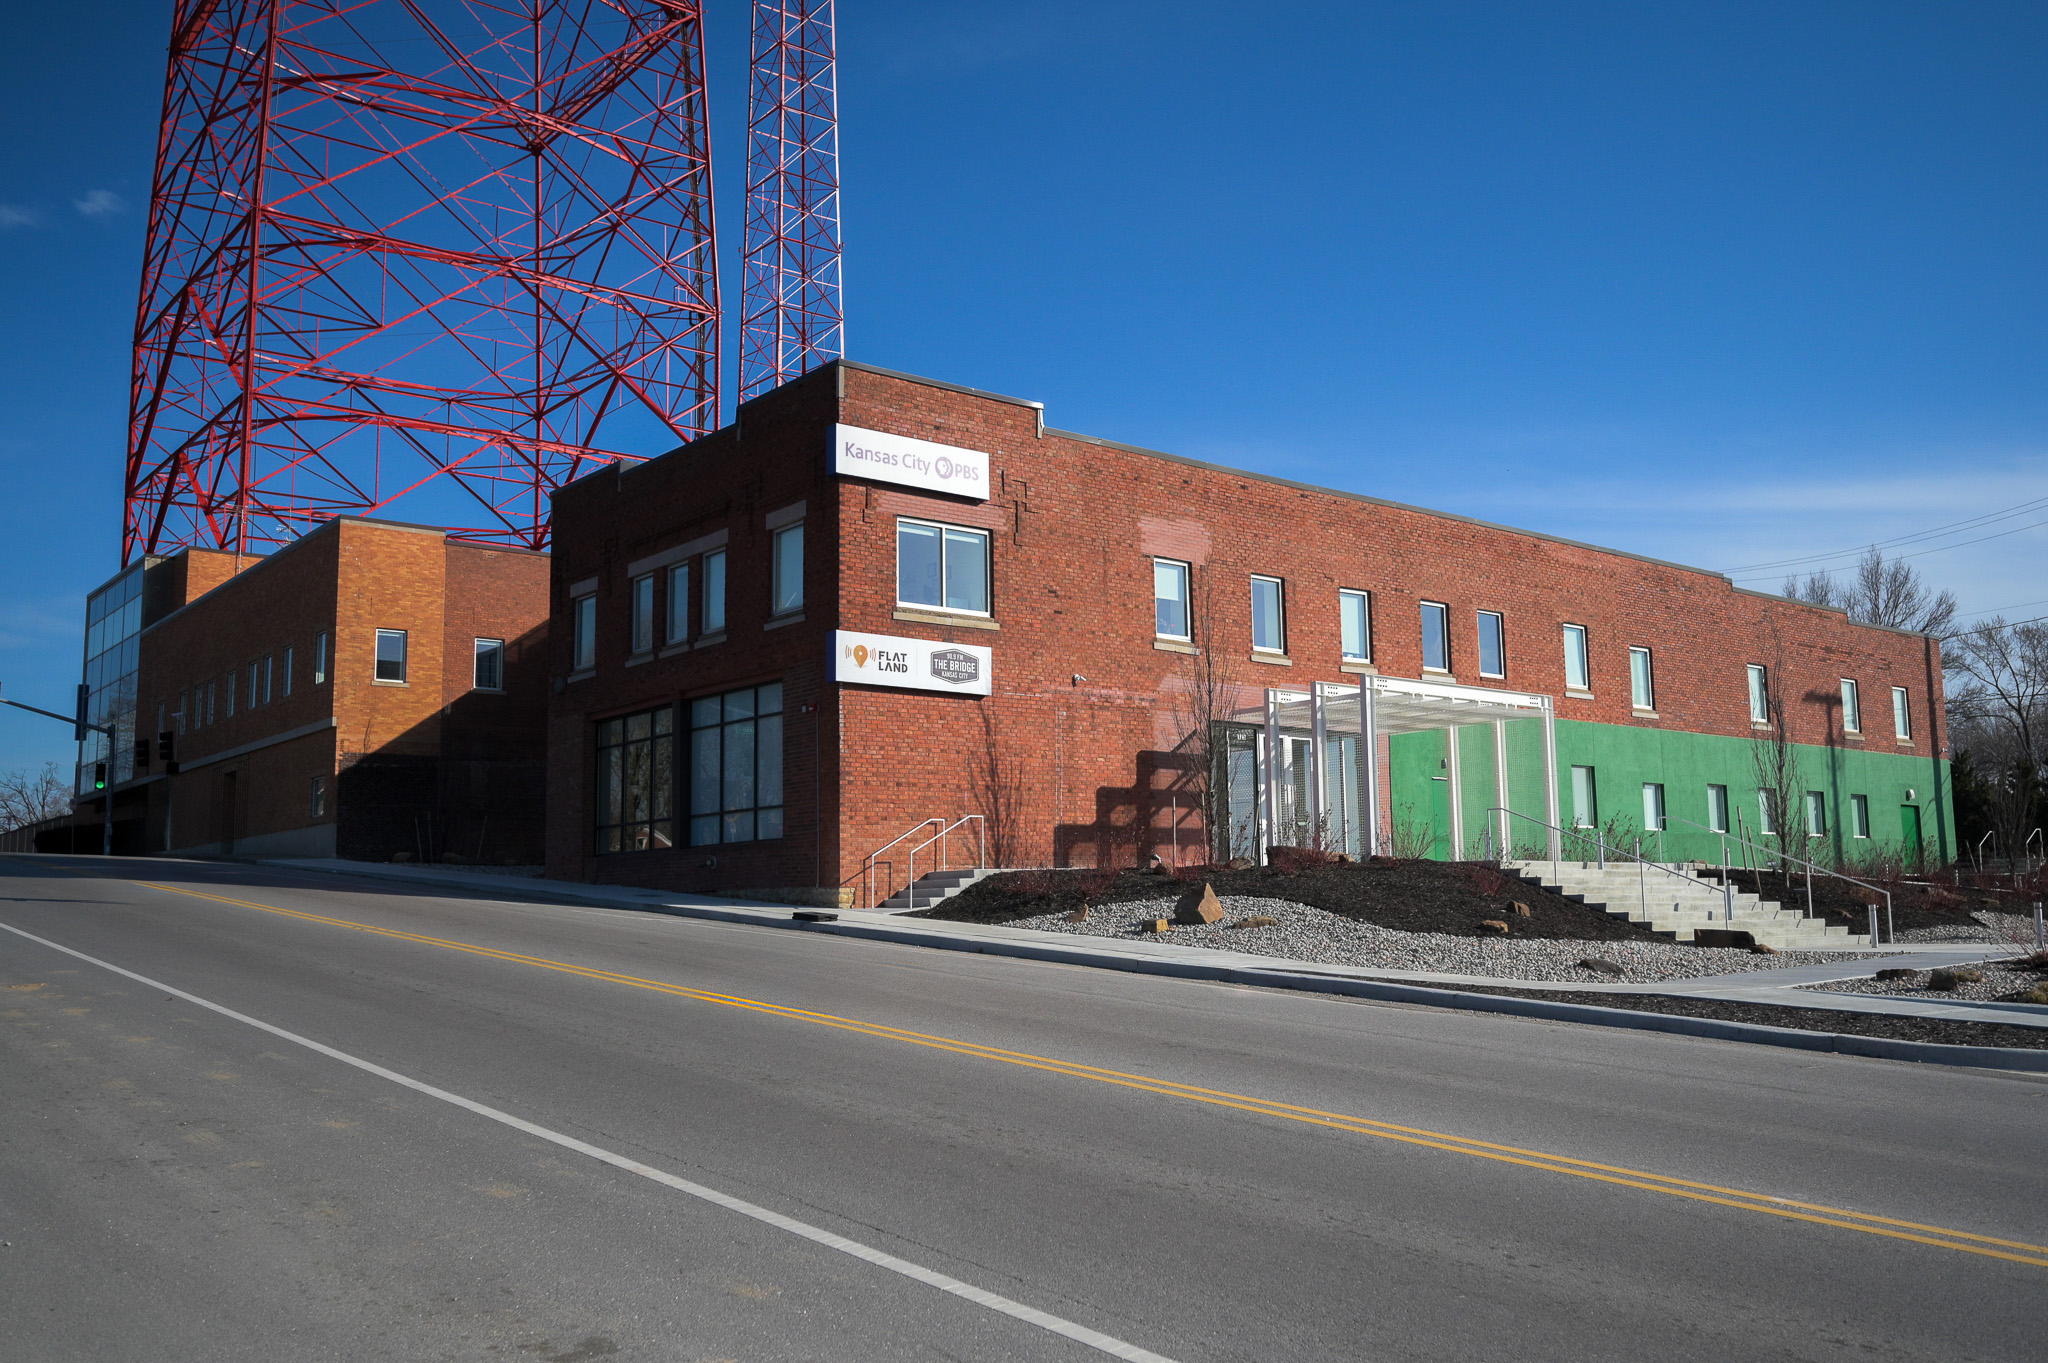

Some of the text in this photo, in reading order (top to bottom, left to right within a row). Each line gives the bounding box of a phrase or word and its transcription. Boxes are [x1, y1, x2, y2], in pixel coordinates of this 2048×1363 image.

[846, 442, 979, 480] Kansas City PBS
[878, 650, 908, 662] FLAT
[878, 662, 908, 673] LAND
[934, 658, 976, 673] THE BRIDGE
